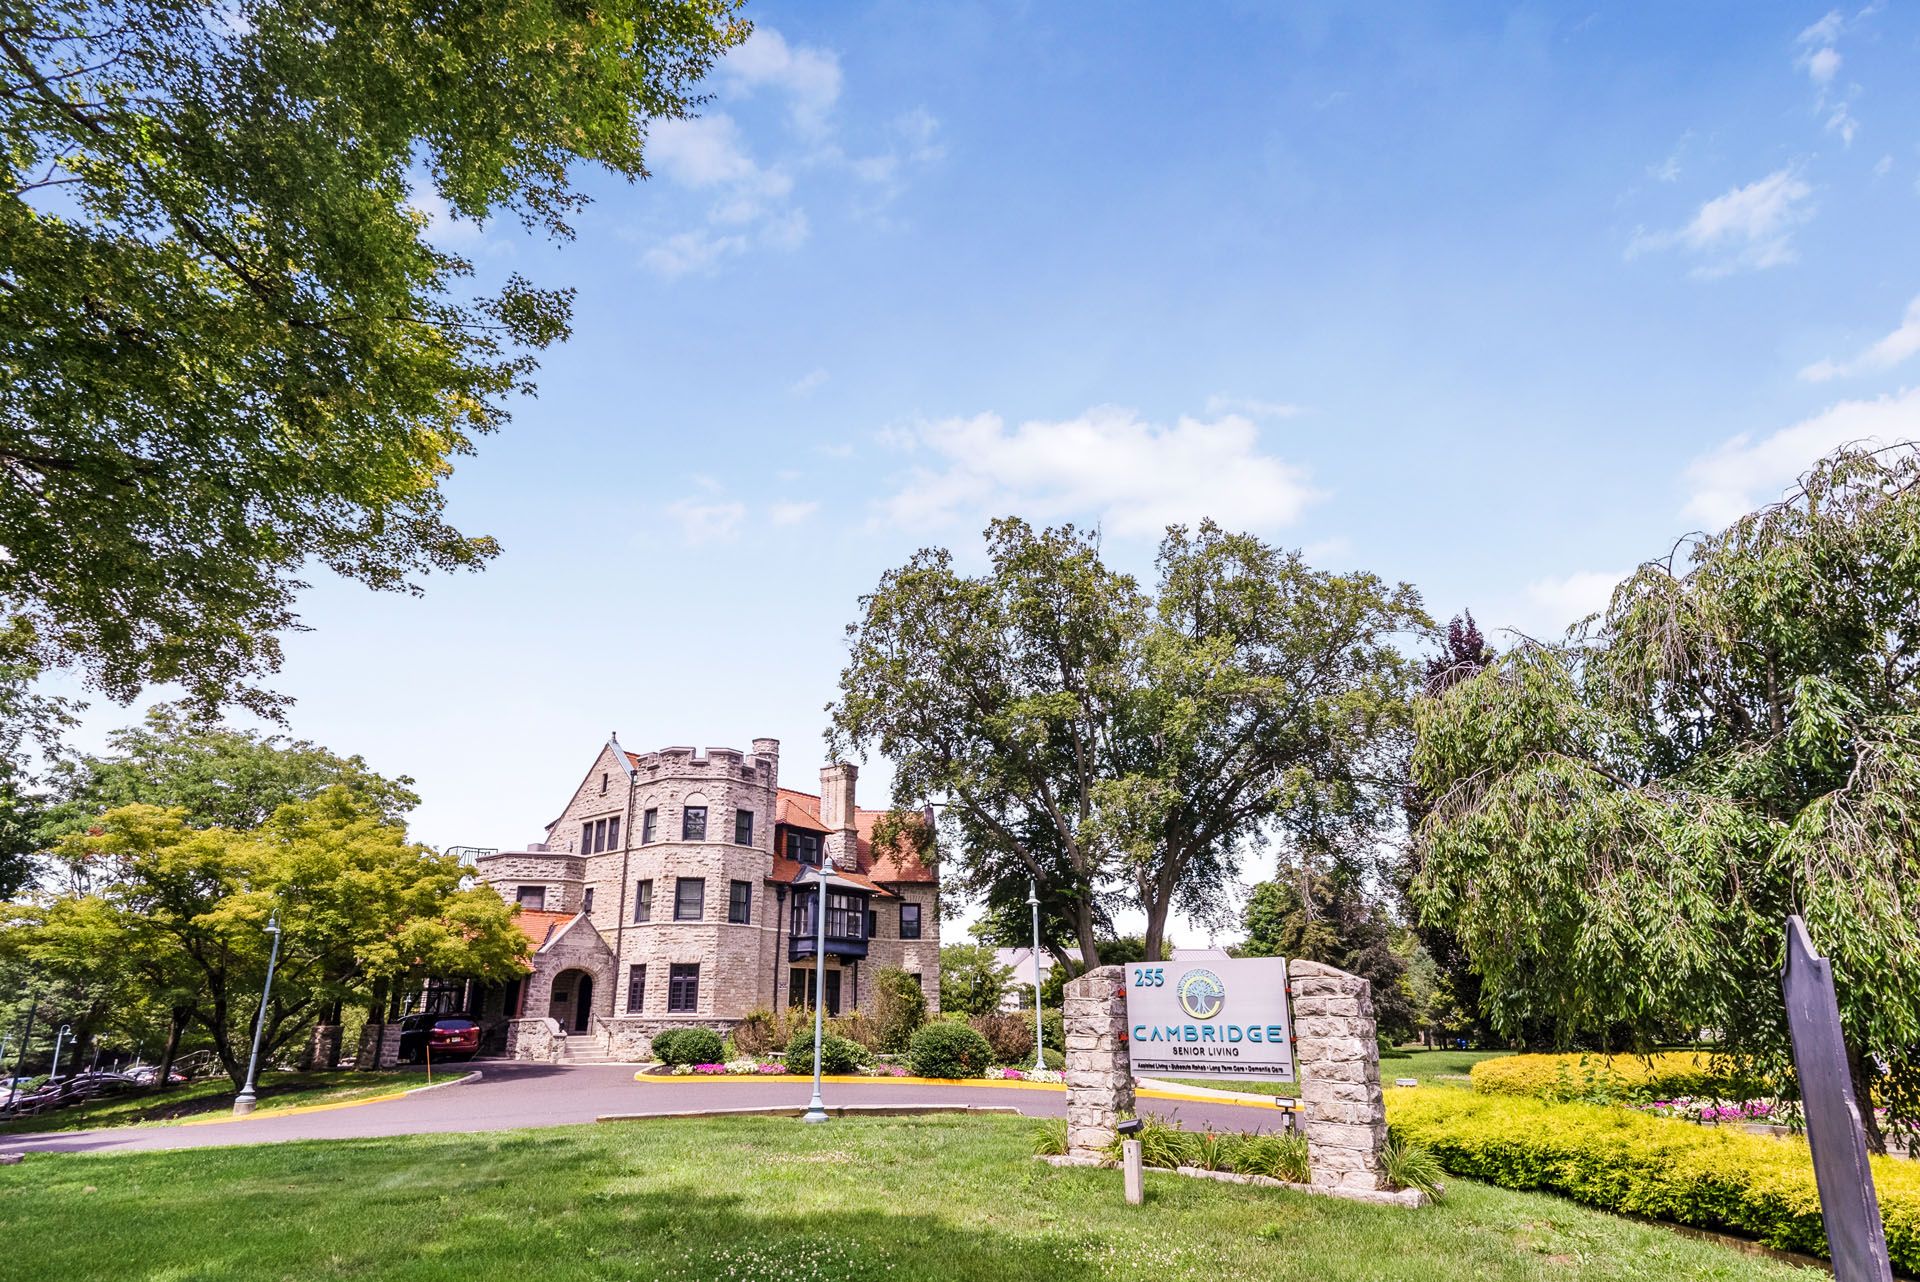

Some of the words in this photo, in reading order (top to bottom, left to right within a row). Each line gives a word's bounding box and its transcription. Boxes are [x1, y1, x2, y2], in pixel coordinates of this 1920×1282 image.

[1134, 968, 1165, 987] 255
[1133, 1024, 1284, 1043] CAMBRIDGE
[1173, 1046, 1206, 1056] SENIOR
[1208, 1047, 1239, 1057] LIVING
[1155, 1062, 1168, 1071] Living
[1209, 1064, 1220, 1072] Long
